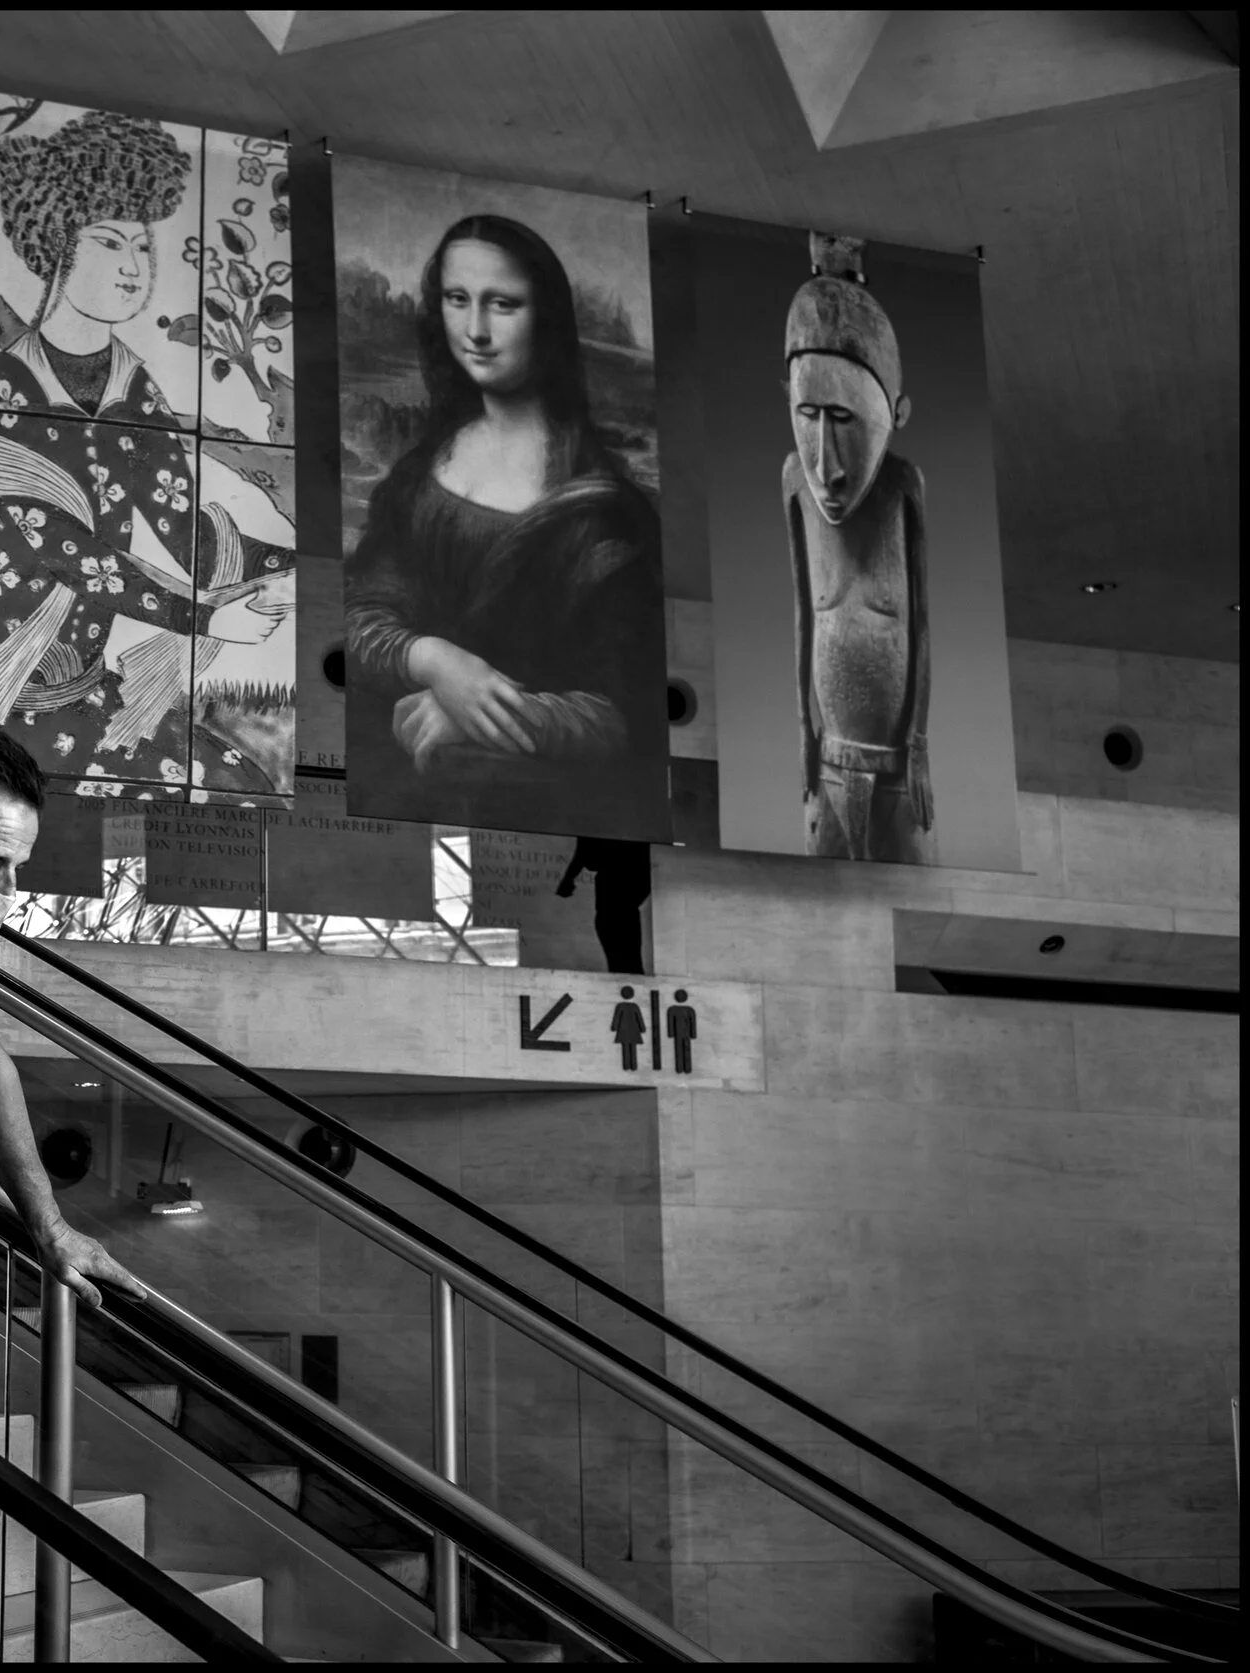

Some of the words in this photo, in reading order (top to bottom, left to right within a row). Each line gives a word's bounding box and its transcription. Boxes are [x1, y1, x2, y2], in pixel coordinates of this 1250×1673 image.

[214, 808, 259, 824] MARC
[175, 822, 255, 840] LYONNAIS
[177, 876, 265, 893] CARREFOU
